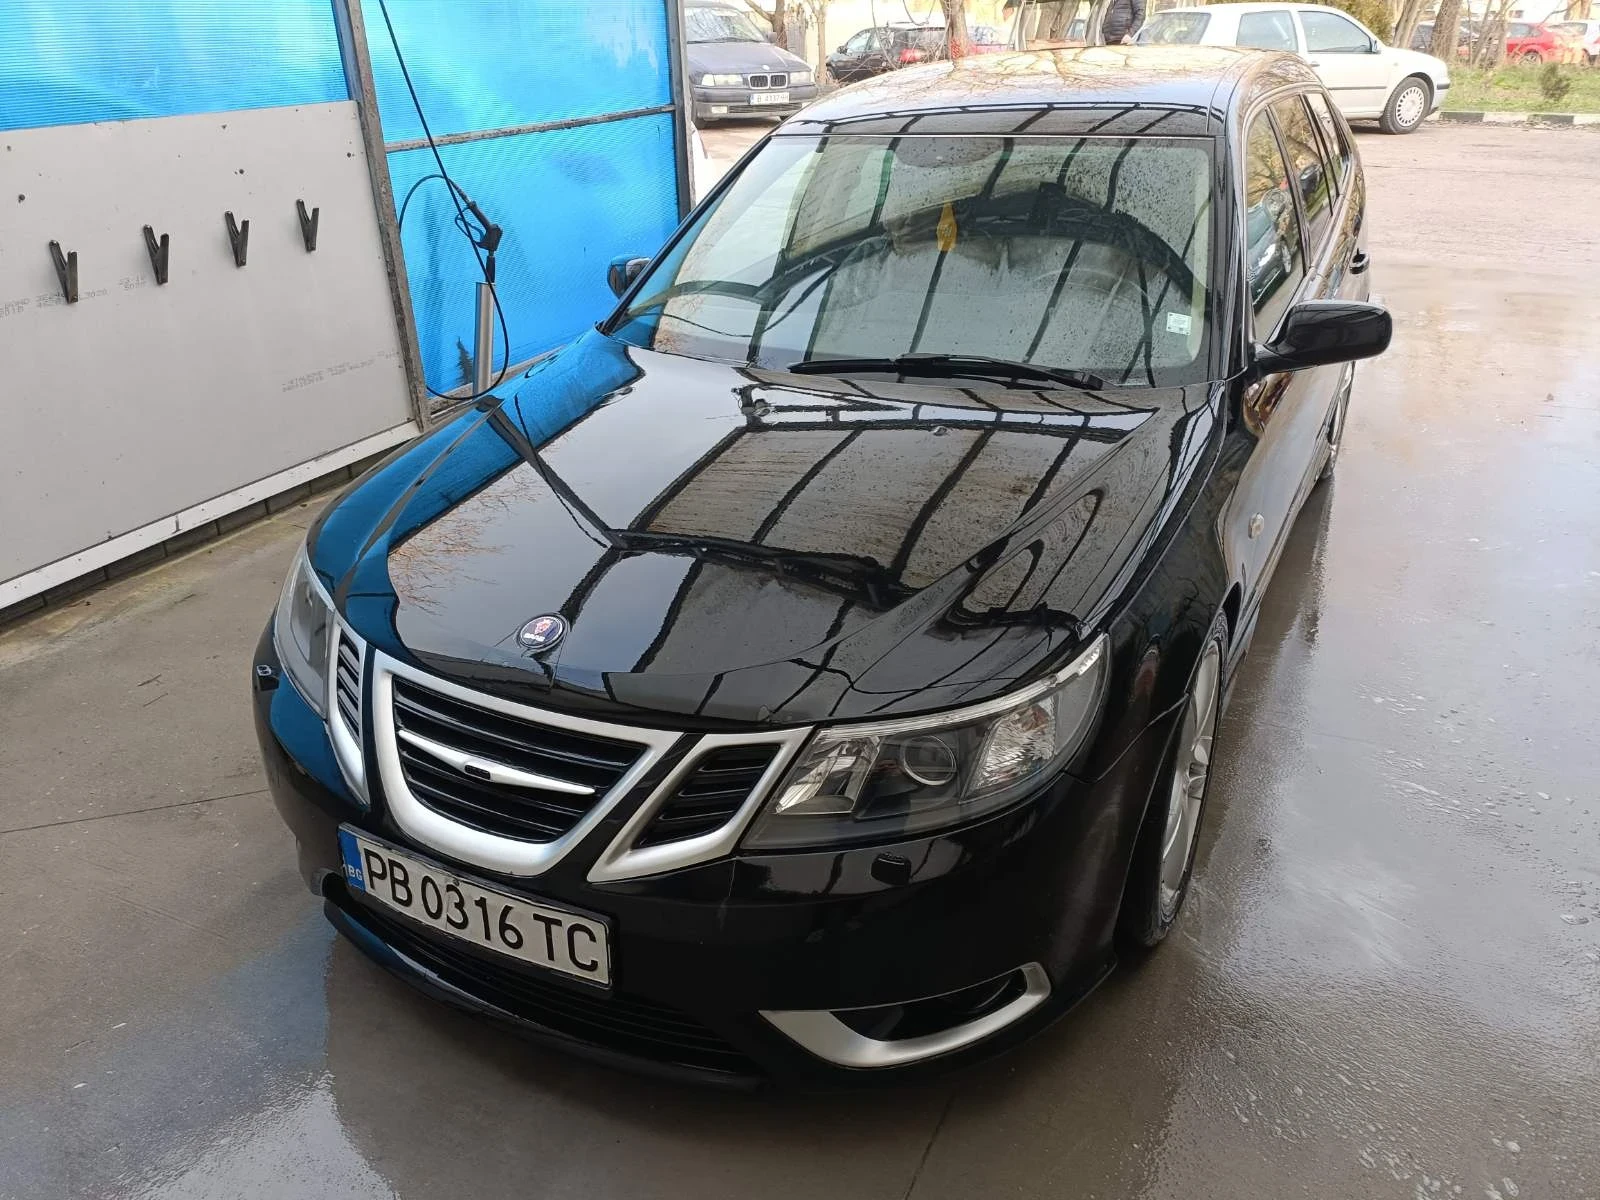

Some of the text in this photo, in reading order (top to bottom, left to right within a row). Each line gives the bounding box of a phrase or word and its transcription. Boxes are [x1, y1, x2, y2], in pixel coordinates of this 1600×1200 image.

[348, 865, 363, 881] BG
[363, 847, 599, 972] PB 0316 TC
